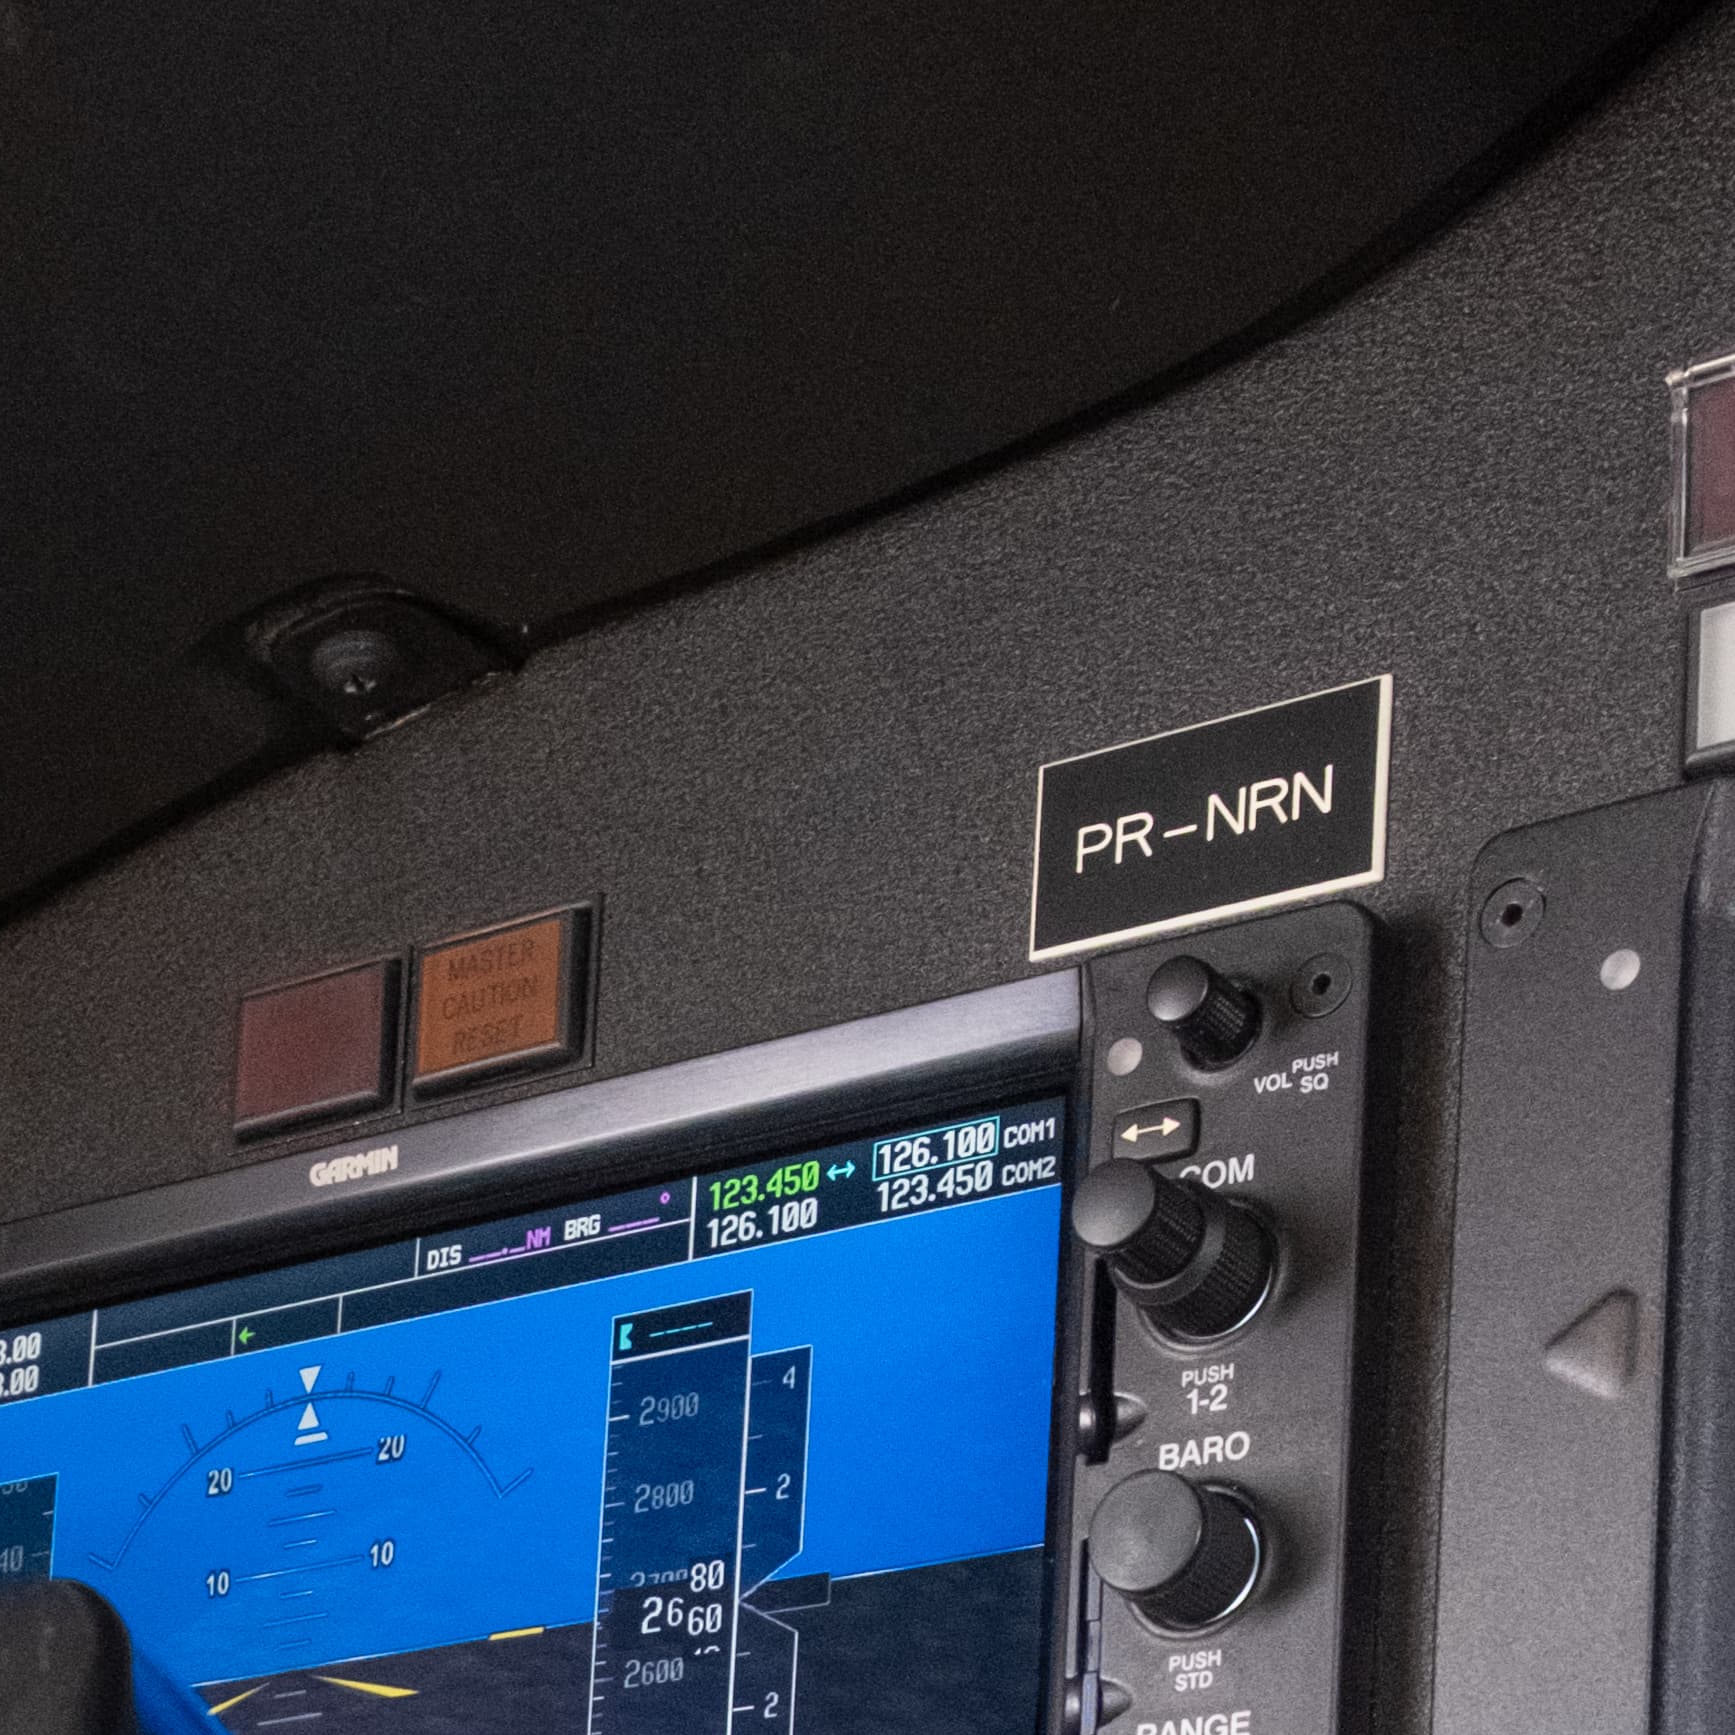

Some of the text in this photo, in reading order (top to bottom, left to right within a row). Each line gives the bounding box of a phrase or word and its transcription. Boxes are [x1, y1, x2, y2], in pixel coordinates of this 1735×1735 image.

[1075, 764, 1334, 874] PR-NRN
[447, 939, 535, 983] MASTER
[442, 974, 538, 1020] CAUTION
[451, 1015, 523, 1055] RESET
[1292, 1051, 1339, 1073] PUSH
[1254, 1072, 1293, 1095] VOL
[309, 1145, 399, 1187] GARMIN
[710, 1118, 1056, 1210] 123.450 126.100 COM1
[707, 1157, 1056, 1248] 126.100 123.450 COM2
[426, 1214, 601, 1270] DIS BRG
[1181, 1364, 1234, 1387] PUSH
[638, 1392, 699, 1426] 2900
[1186, 1385, 1228, 1415] 1-2
[1158, 1432, 1250, 1471] BARO
[634, 1479, 694, 1513] 2800
[624, 1657, 684, 1688] 2600
[1169, 1649, 1222, 1672] PUSH
